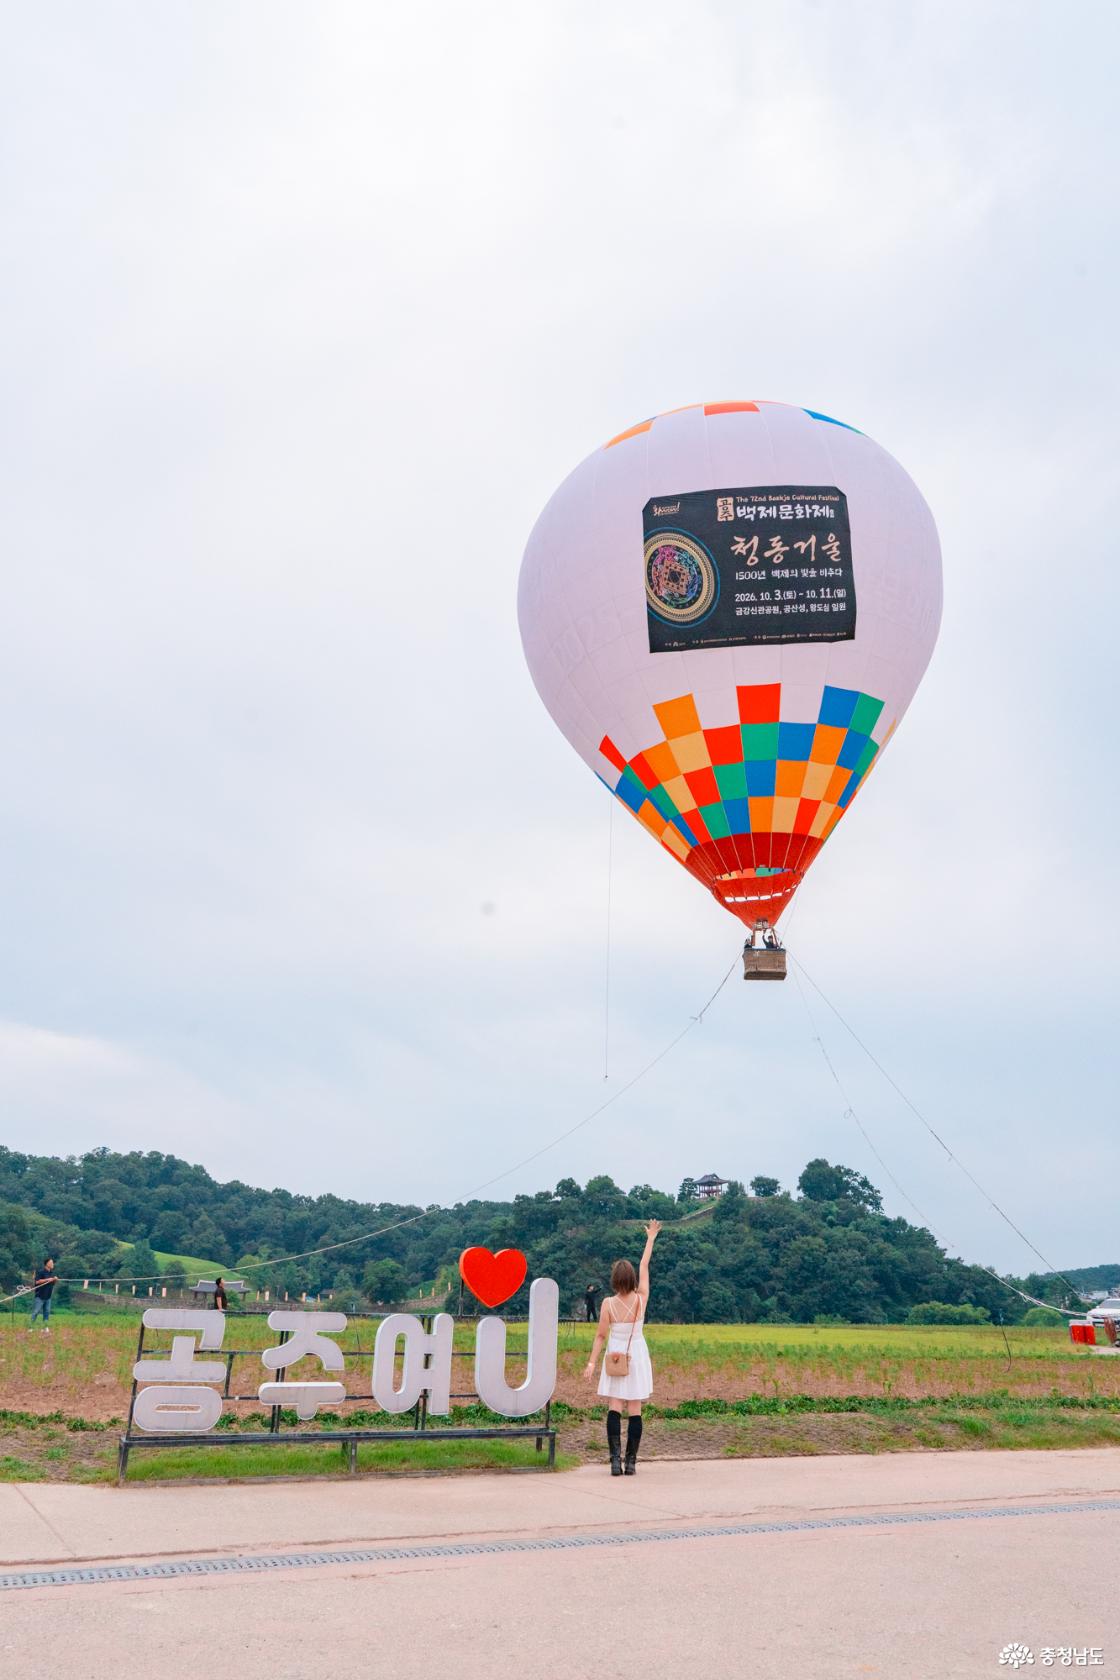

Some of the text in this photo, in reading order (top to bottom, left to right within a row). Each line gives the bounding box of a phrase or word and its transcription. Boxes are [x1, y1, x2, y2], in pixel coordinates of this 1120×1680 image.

[818, 494, 840, 502] Festival
[736, 503, 830, 521] 백제문화제
[730, 532, 841, 565] 청동거울
[735, 567, 843, 580] 1500년 백제의 빛을 비추다
[735, 592, 758, 602] 2026.
[760, 591, 772, 601] 10.
[806, 589, 818, 599] 10.
[832, 601, 847, 612] 일원
